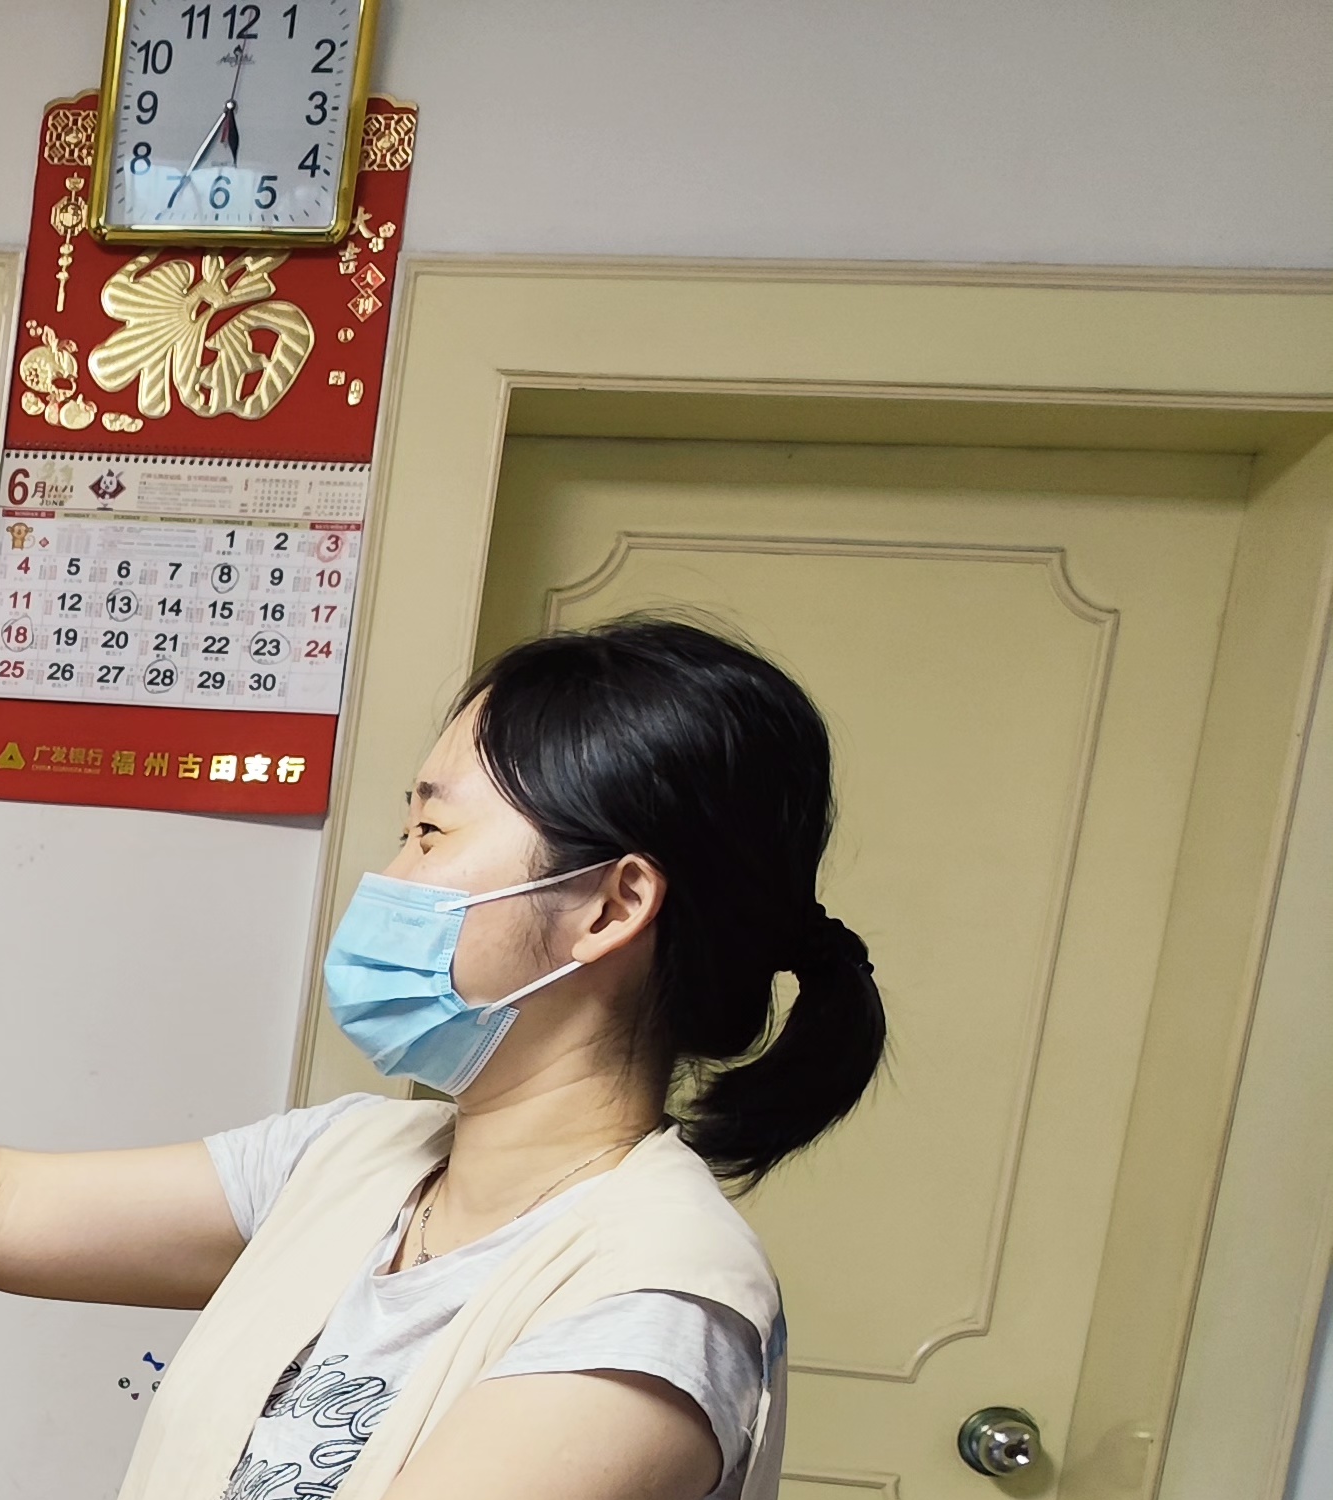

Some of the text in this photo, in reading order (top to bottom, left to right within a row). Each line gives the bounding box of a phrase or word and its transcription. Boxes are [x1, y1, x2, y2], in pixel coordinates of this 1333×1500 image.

[182, 5, 296, 39] 11 12 1
[138, 39, 336, 75] 10 2
[136, 92, 327, 125] 9 3
[130, 143, 320, 179] 8 4
[166, 176, 277, 210] 7 6 5
[338, 205, 375, 274] 大吉
[226, 531, 340, 552] 1 2 3
[16, 557, 341, 588] 4 5 6 7 8 9 10
[9, 592, 336, 623] 11 12 13 14 15 16 17
[3, 626, 332, 658] 18 19 20 21 22 23 24
[47, 664, 74, 681] 26
[97, 666, 125, 684] 27
[147, 669, 174, 686] 28
[197, 672, 225, 689] 29
[249, 674, 276, 691] 30
[33, 745, 306, 784] 广发银行 福州古田支行
